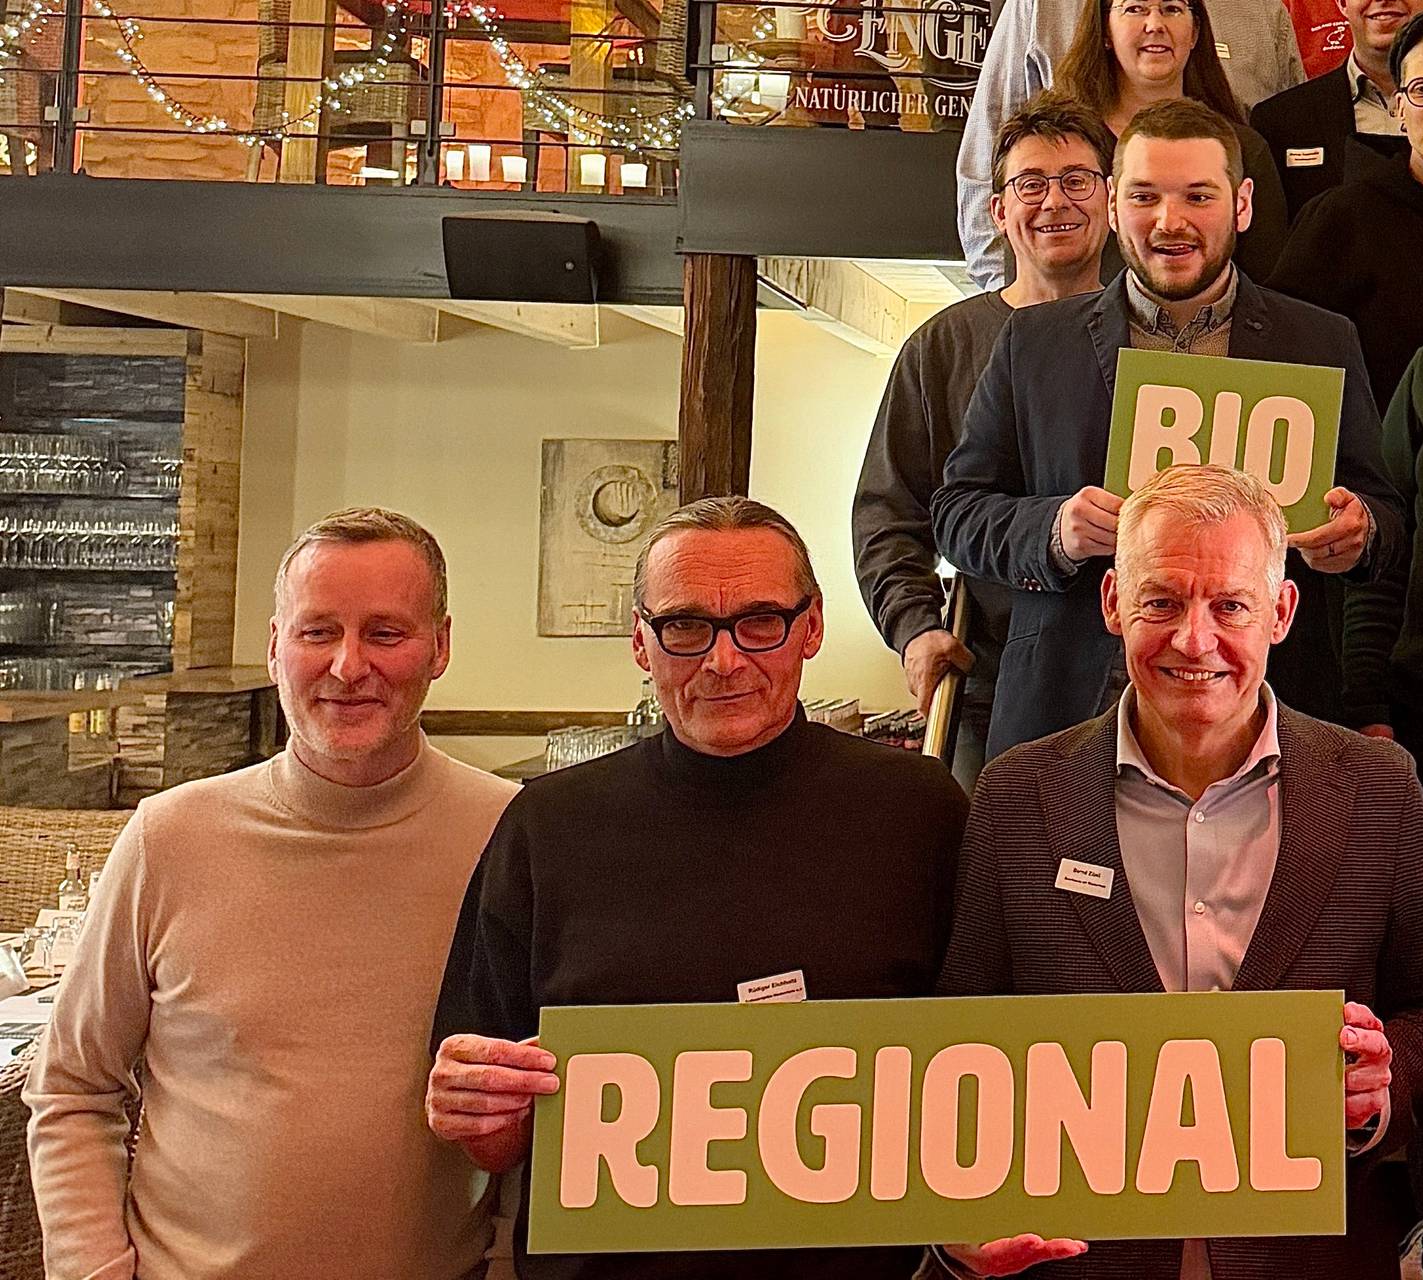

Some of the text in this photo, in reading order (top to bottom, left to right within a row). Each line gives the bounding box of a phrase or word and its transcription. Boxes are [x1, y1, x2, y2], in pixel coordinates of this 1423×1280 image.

[794, 83, 929, 116] NATÜRLICHER
[1127, 383, 1315, 507] BIO
[559, 1037, 1323, 1208] REGIONAL
